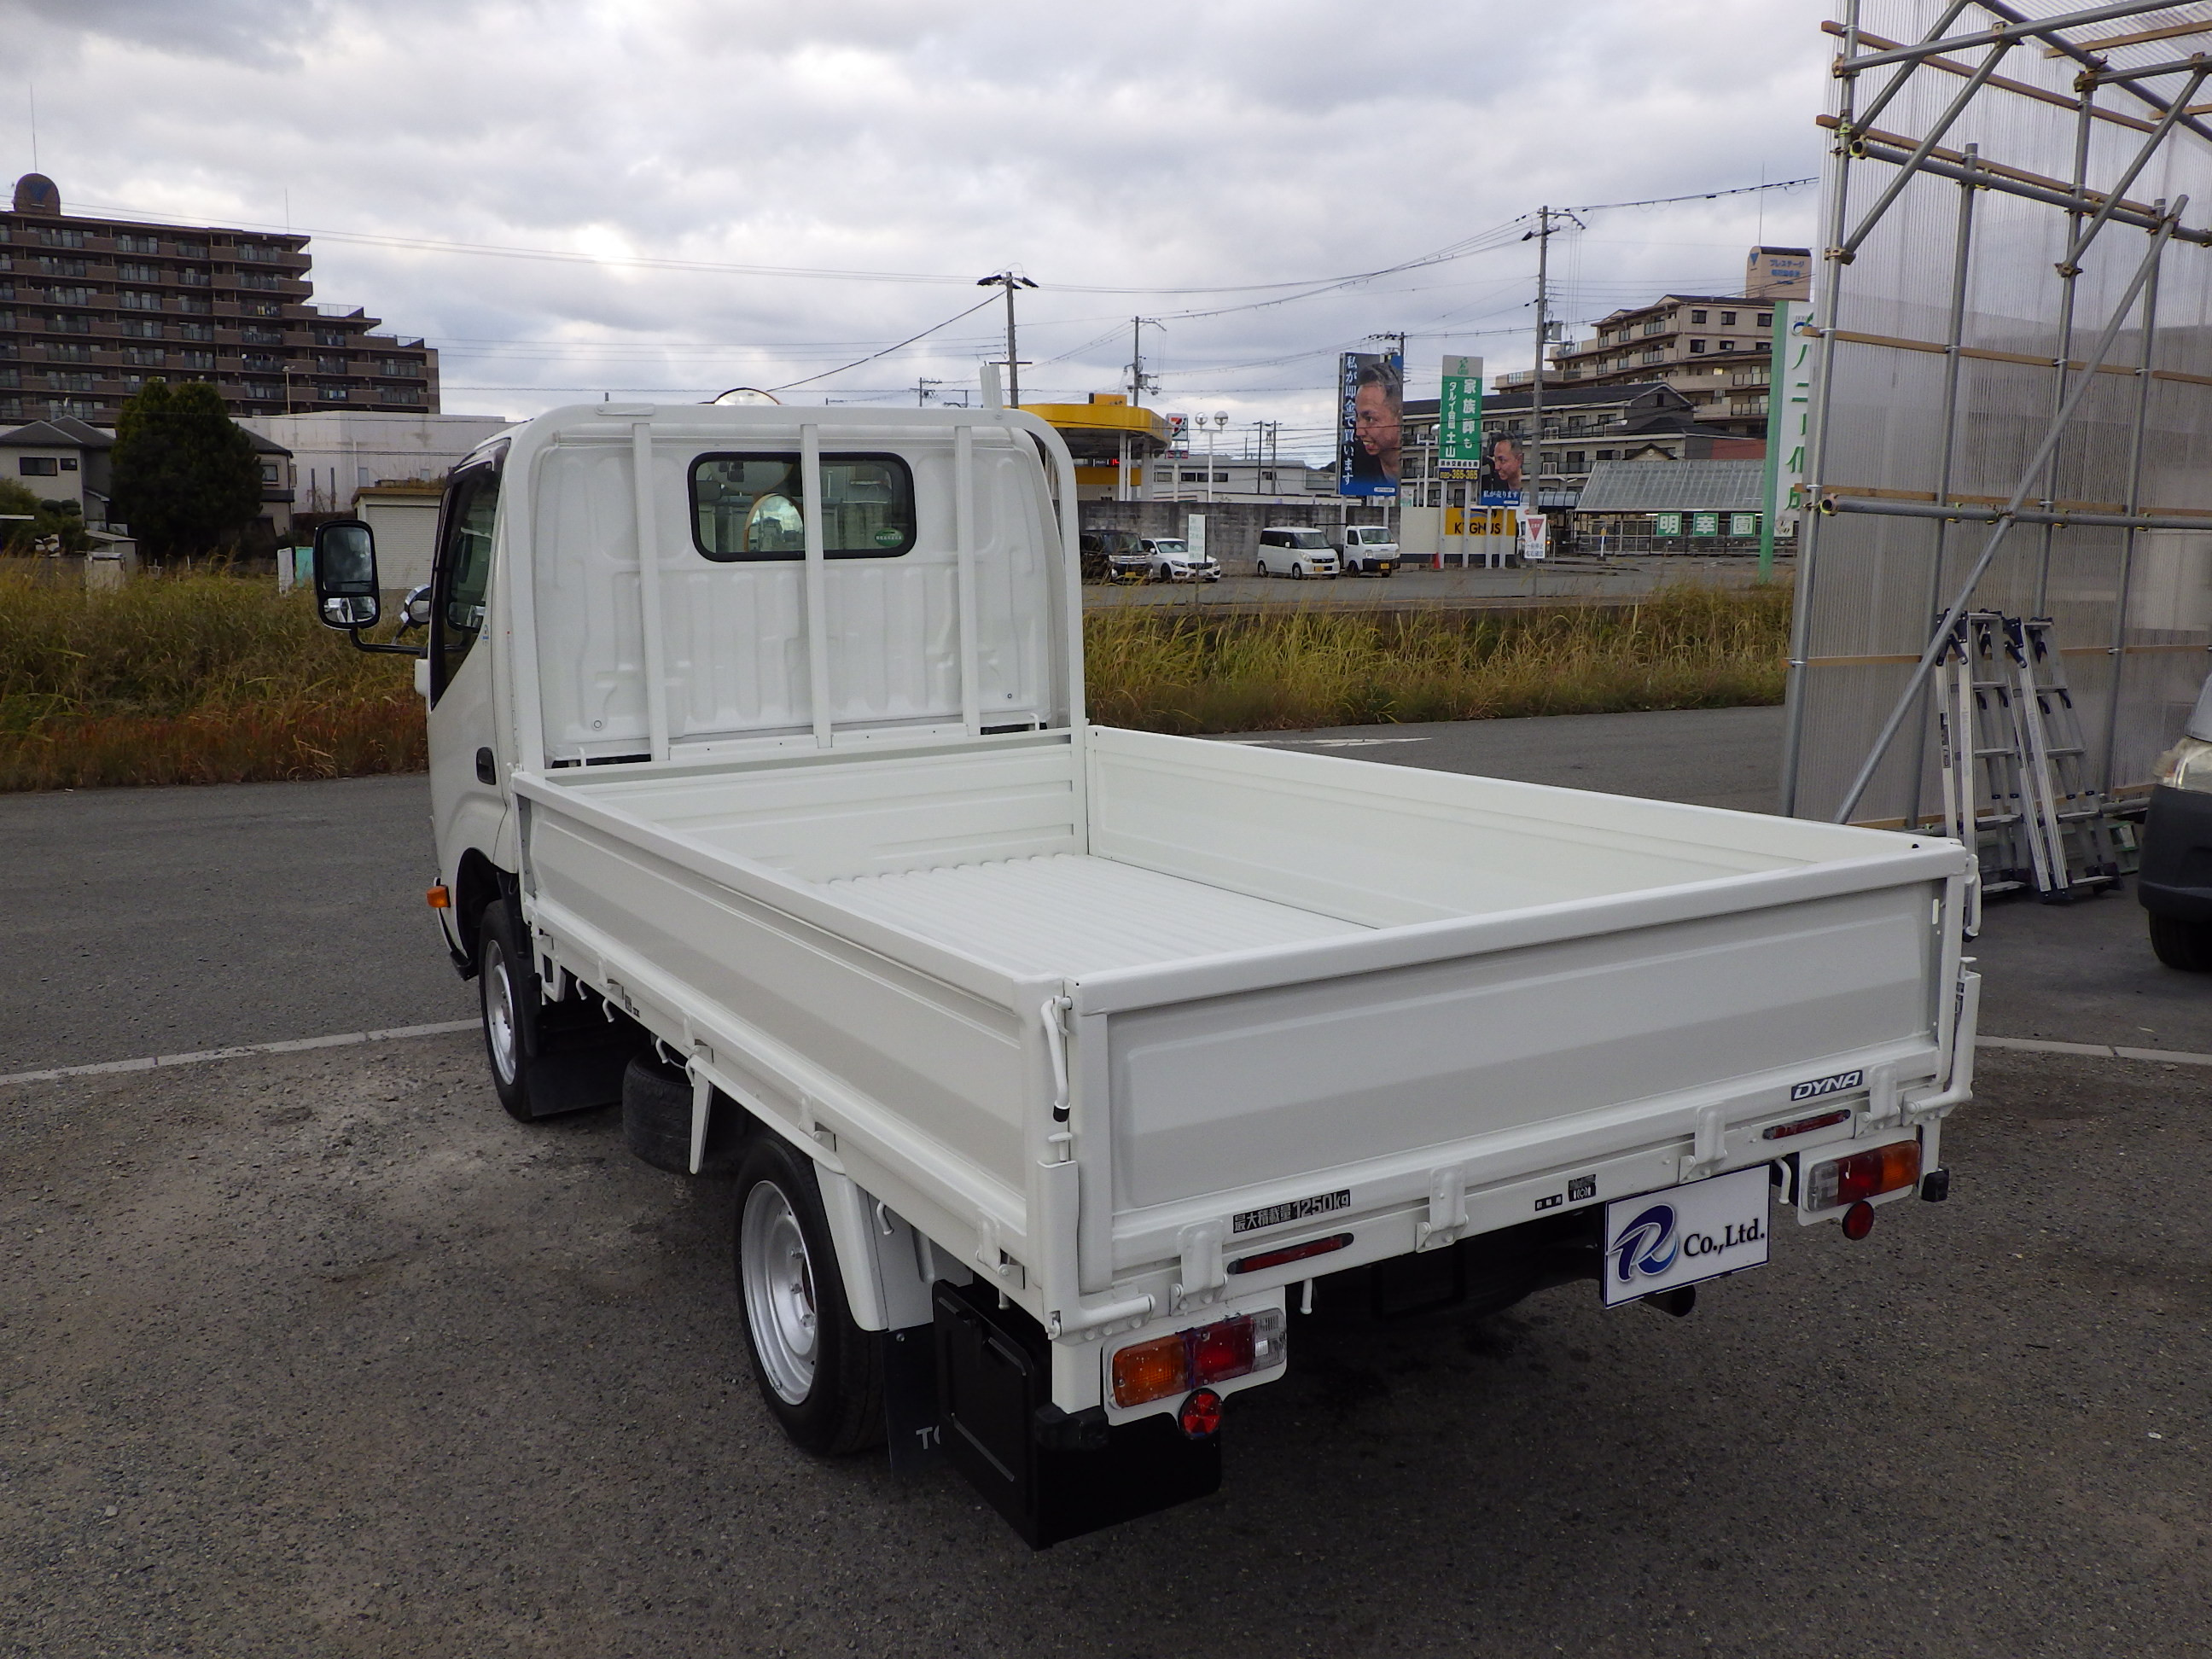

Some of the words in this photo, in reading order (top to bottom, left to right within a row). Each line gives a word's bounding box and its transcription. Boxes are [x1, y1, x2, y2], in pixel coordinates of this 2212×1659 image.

[1342, 355, 1358, 485] 私が即金で買います
[1462, 379, 1476, 449] 家族葬も
[1483, 490, 1518, 498] 私が売ります
[1659, 515, 1753, 535] 明幸園
[1794, 1071, 1860, 1099] DYNA
[1684, 1218, 1765, 1257] Co.,Ltd.
